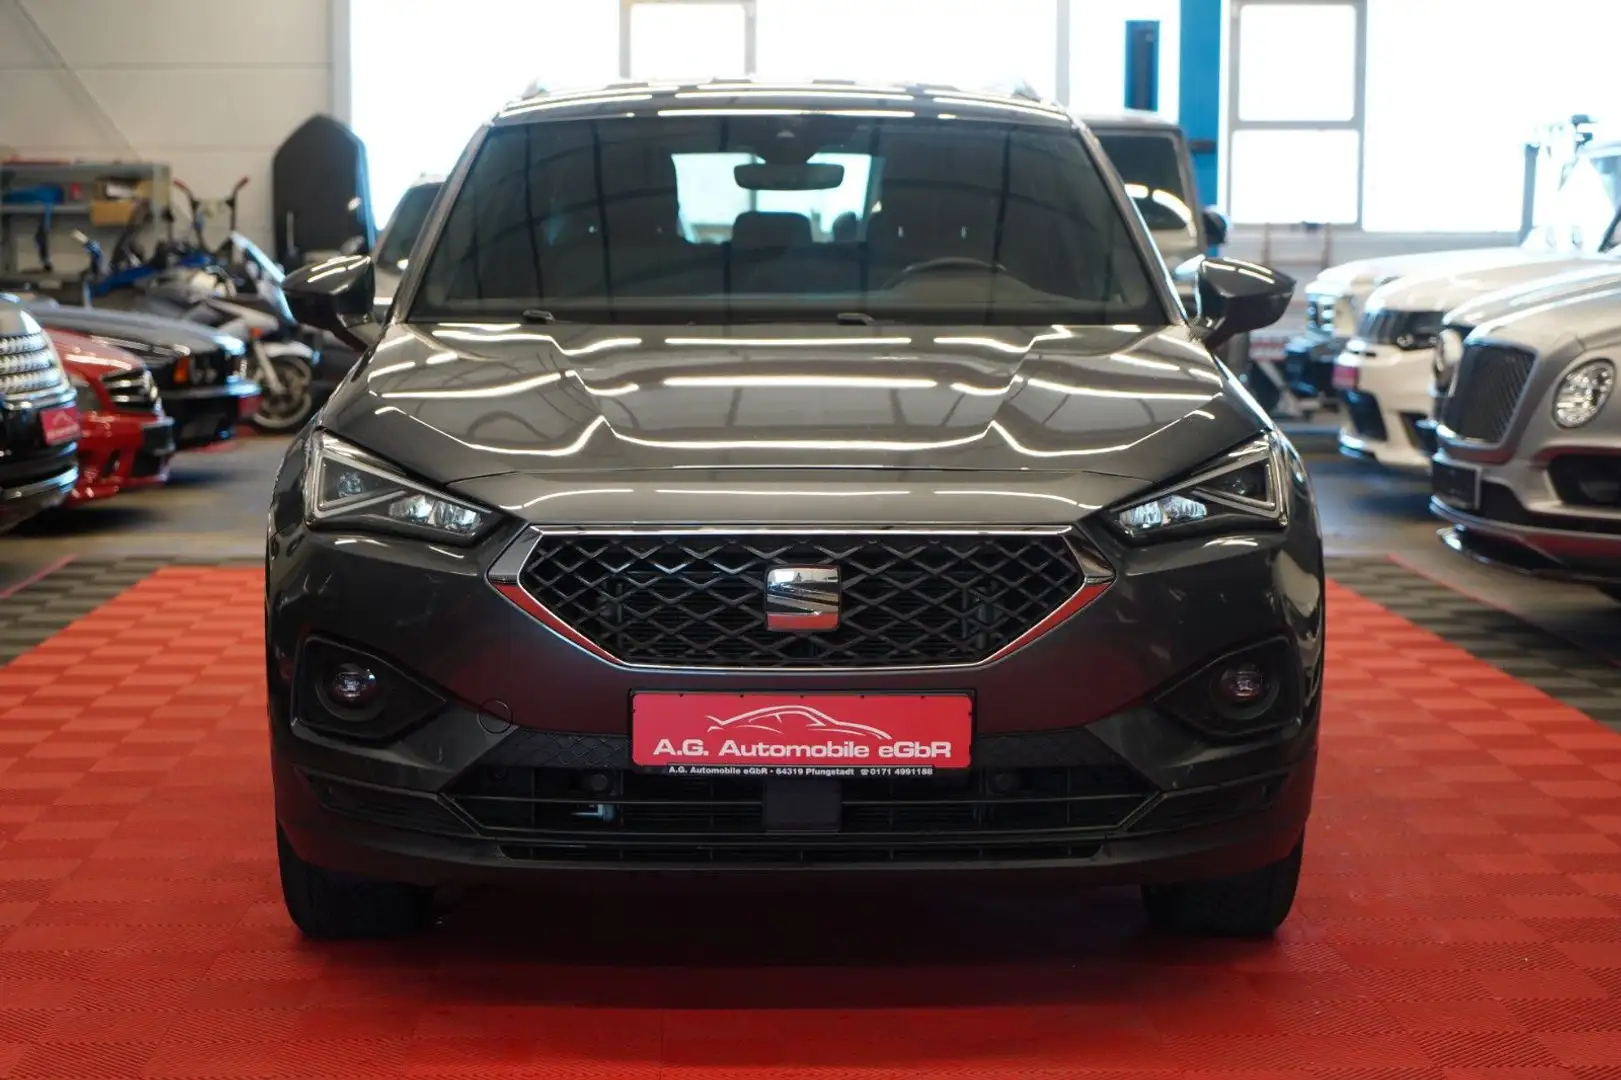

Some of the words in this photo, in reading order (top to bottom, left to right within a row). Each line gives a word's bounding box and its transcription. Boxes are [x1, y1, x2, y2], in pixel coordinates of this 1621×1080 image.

[653, 738, 709, 756] A.G.
[718, 740, 870, 757] Automobile
[878, 741, 952, 758] eGbR
[668, 766, 688, 774] A.G.
[690, 766, 741, 775] Automobile
[743, 767, 768, 775] eGbR
[805, 767, 851, 777] Pfungstadt
[870, 767, 892, 776] 0171
